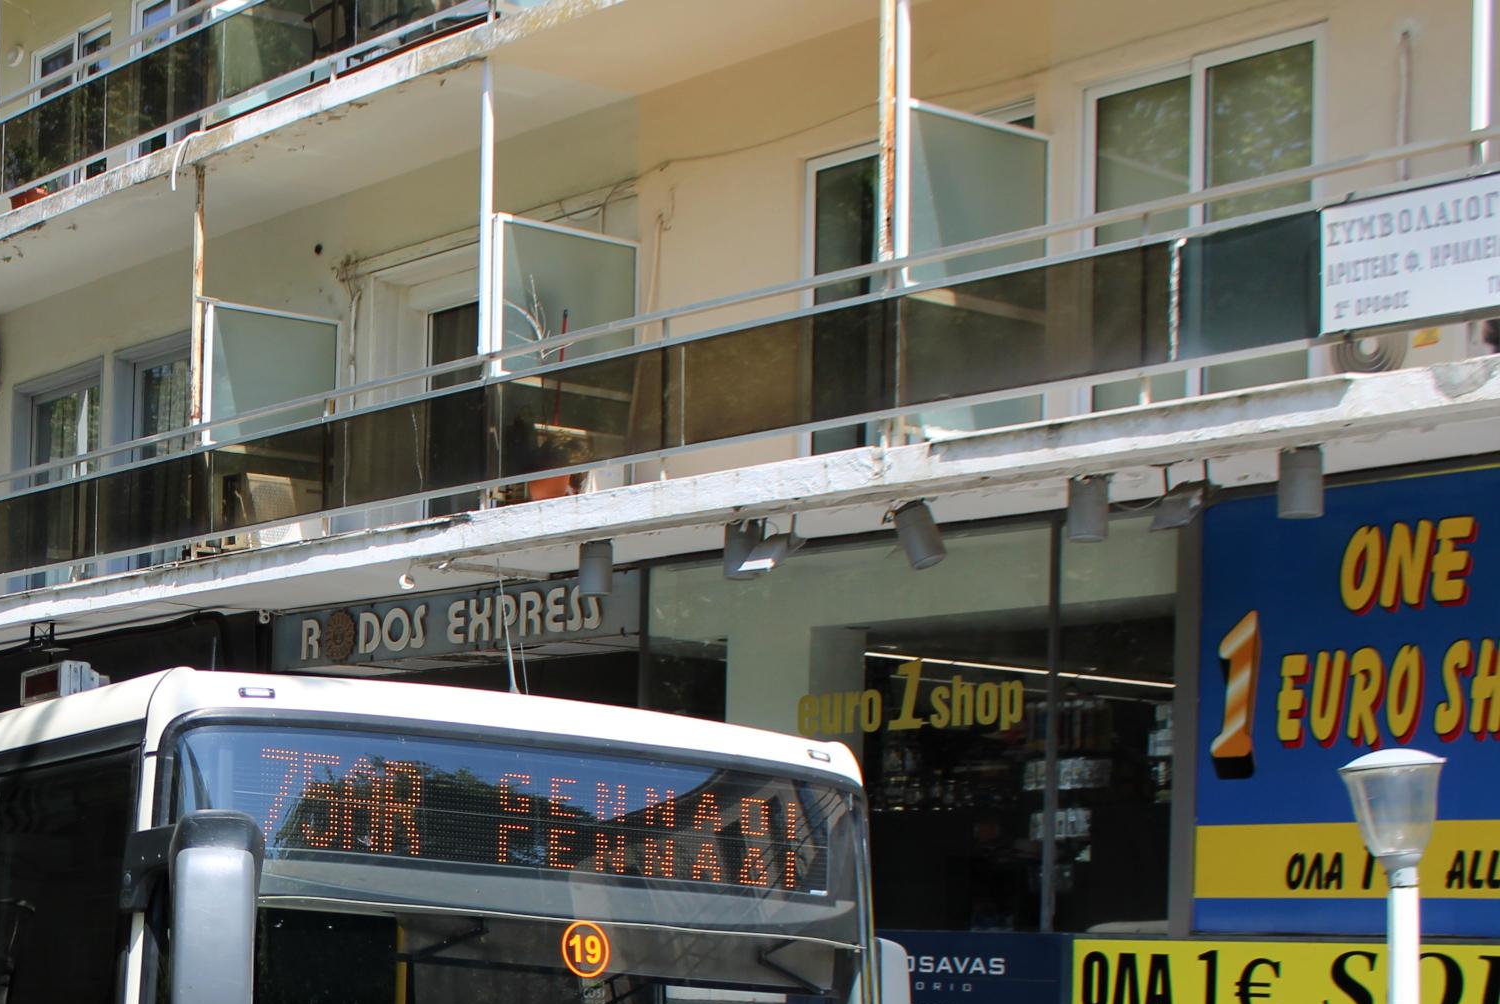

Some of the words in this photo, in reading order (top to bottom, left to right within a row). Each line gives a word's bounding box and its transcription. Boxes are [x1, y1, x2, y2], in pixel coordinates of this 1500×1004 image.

[1325, 191, 1500, 247] ΣΥΜΒΟΛΑΙΟΓ
[1325, 253, 1399, 287] ΑΡΙΣΤΕΑΣ
[1340, 516, 1478, 615] ONE
[446, 584, 601, 645] EXPRESS
[797, 688, 882, 737] euro
[887, 657, 923, 730] 1
[929, 674, 1024, 731] shop
[1277, 644, 1425, 751] EURO
[1286, 852, 1343, 890] ΟΛΑ
[1446, 849, 1500, 890] ALL
[569, 934, 602, 966] 19
